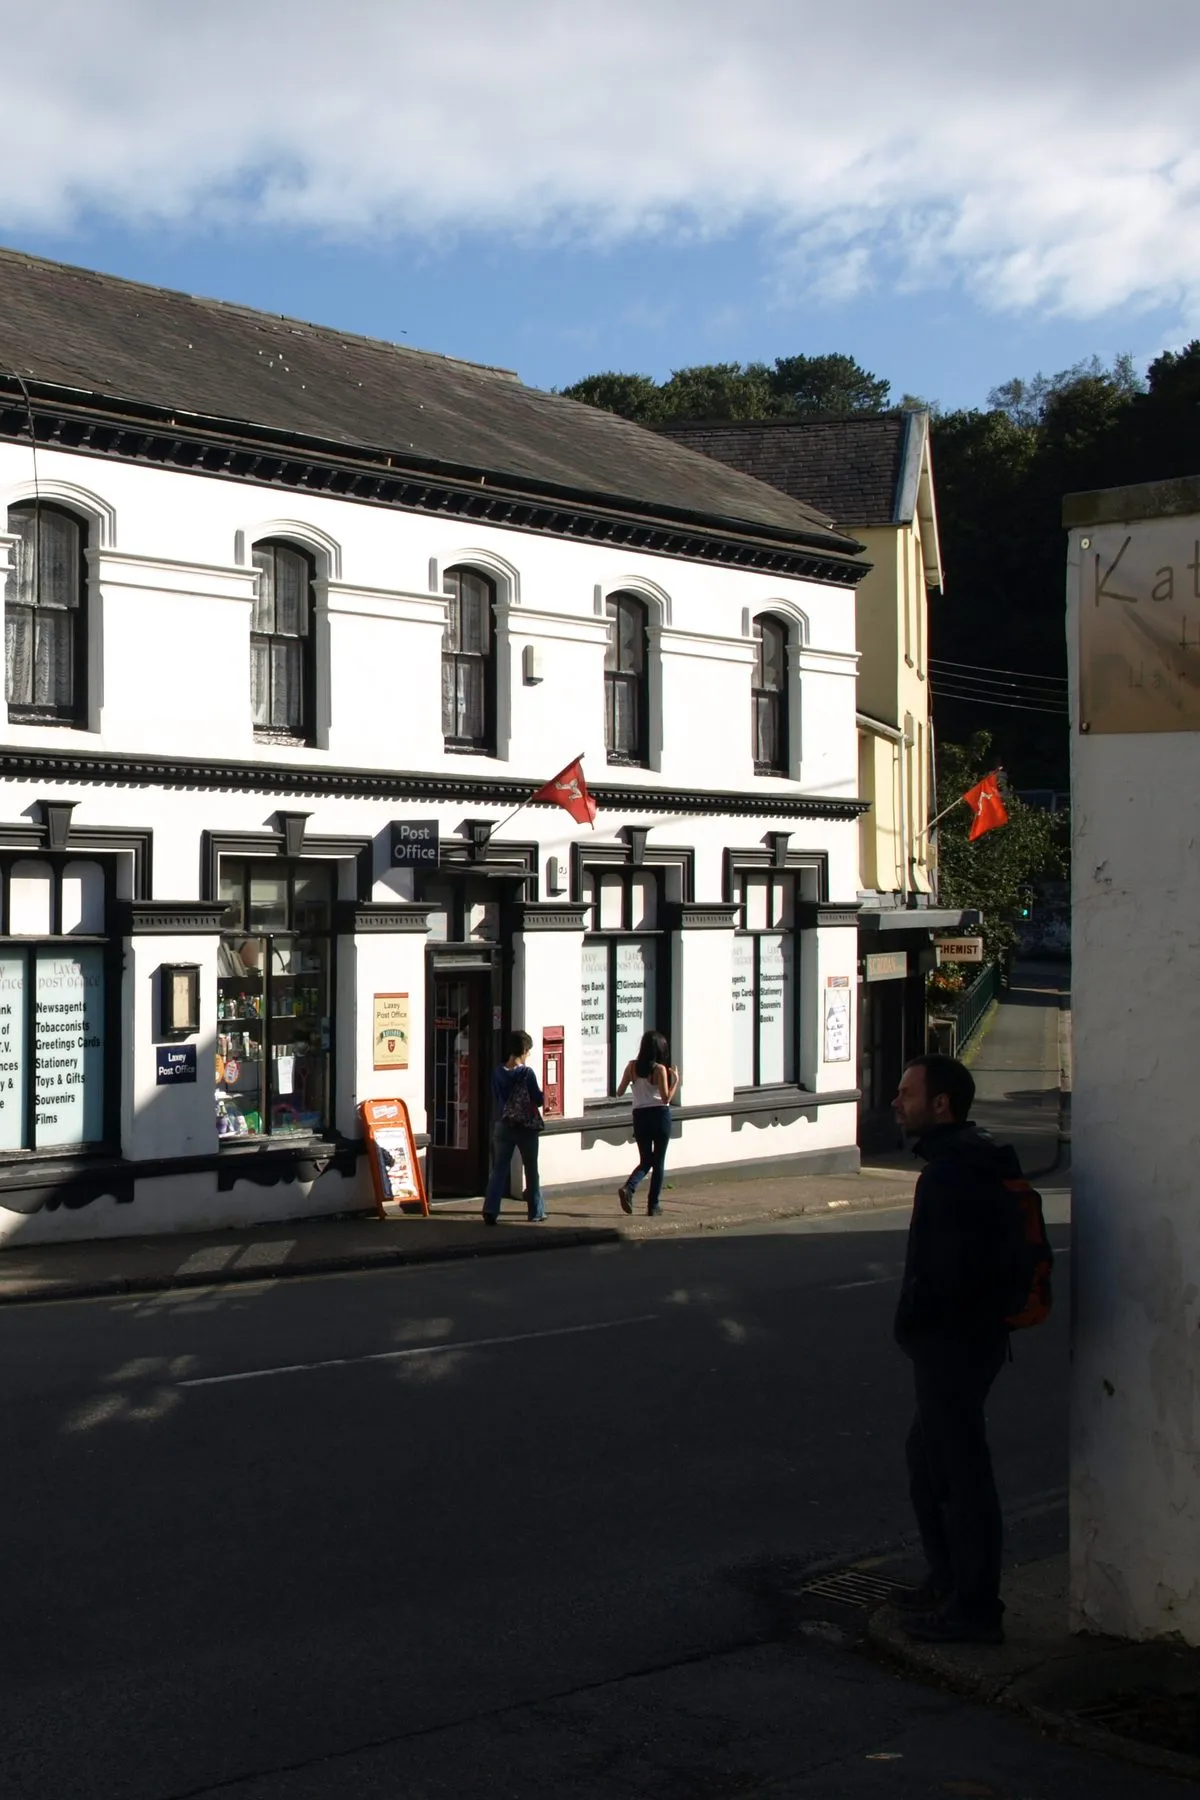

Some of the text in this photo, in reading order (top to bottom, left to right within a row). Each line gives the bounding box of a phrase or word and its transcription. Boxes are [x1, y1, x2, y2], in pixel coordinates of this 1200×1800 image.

[400, 825, 430, 840] Post
[394, 844, 436, 859] Office
[591, 981, 605, 991] Bank
[617, 994, 643, 1005] Telephone
[36, 1001, 87, 1015] Newsagents
[617, 1008, 643, 1019] Electricity
[580, 1011, 604, 1021] Licences
[1, 1023, 10, 1035] of
[36, 1020, 90, 1034] Tobacconists
[36, 1038, 76, 1051] Greetings
[36, 1056, 79, 1070] Stationery
[167, 1053, 187, 1063] Laxey
[158, 1065, 195, 1076] Post Office
[7, 1078, 14, 1089] &
[36, 1073, 86, 1088] Toys & Gifts
[36, 1092, 76, 1106] Souvenirs
[36, 1113, 58, 1125] Films
